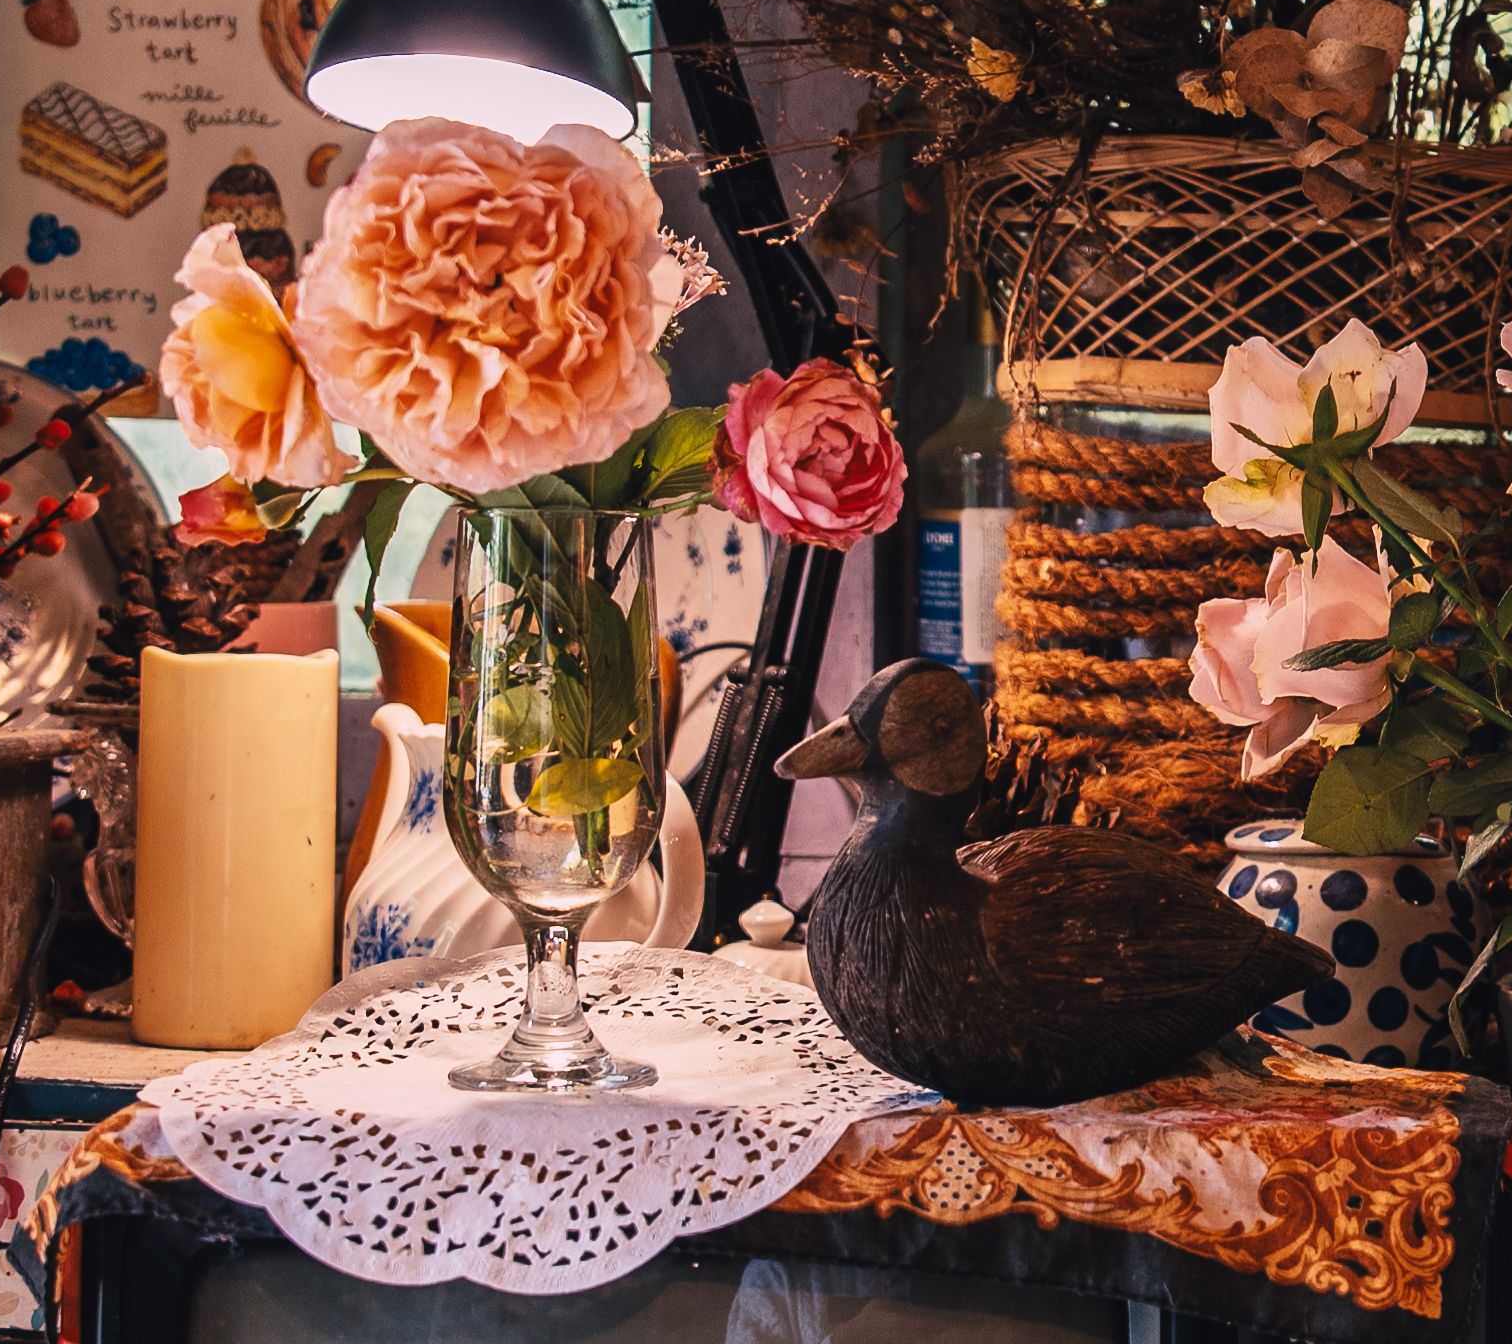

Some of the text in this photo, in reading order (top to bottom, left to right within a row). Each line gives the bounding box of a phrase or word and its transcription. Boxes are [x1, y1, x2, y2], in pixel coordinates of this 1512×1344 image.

[107, 5, 237, 42] Strawberry
[145, 40, 199, 65] tart
[27, 283, 158, 314] blueberry
[67, 313, 118, 333] tart
